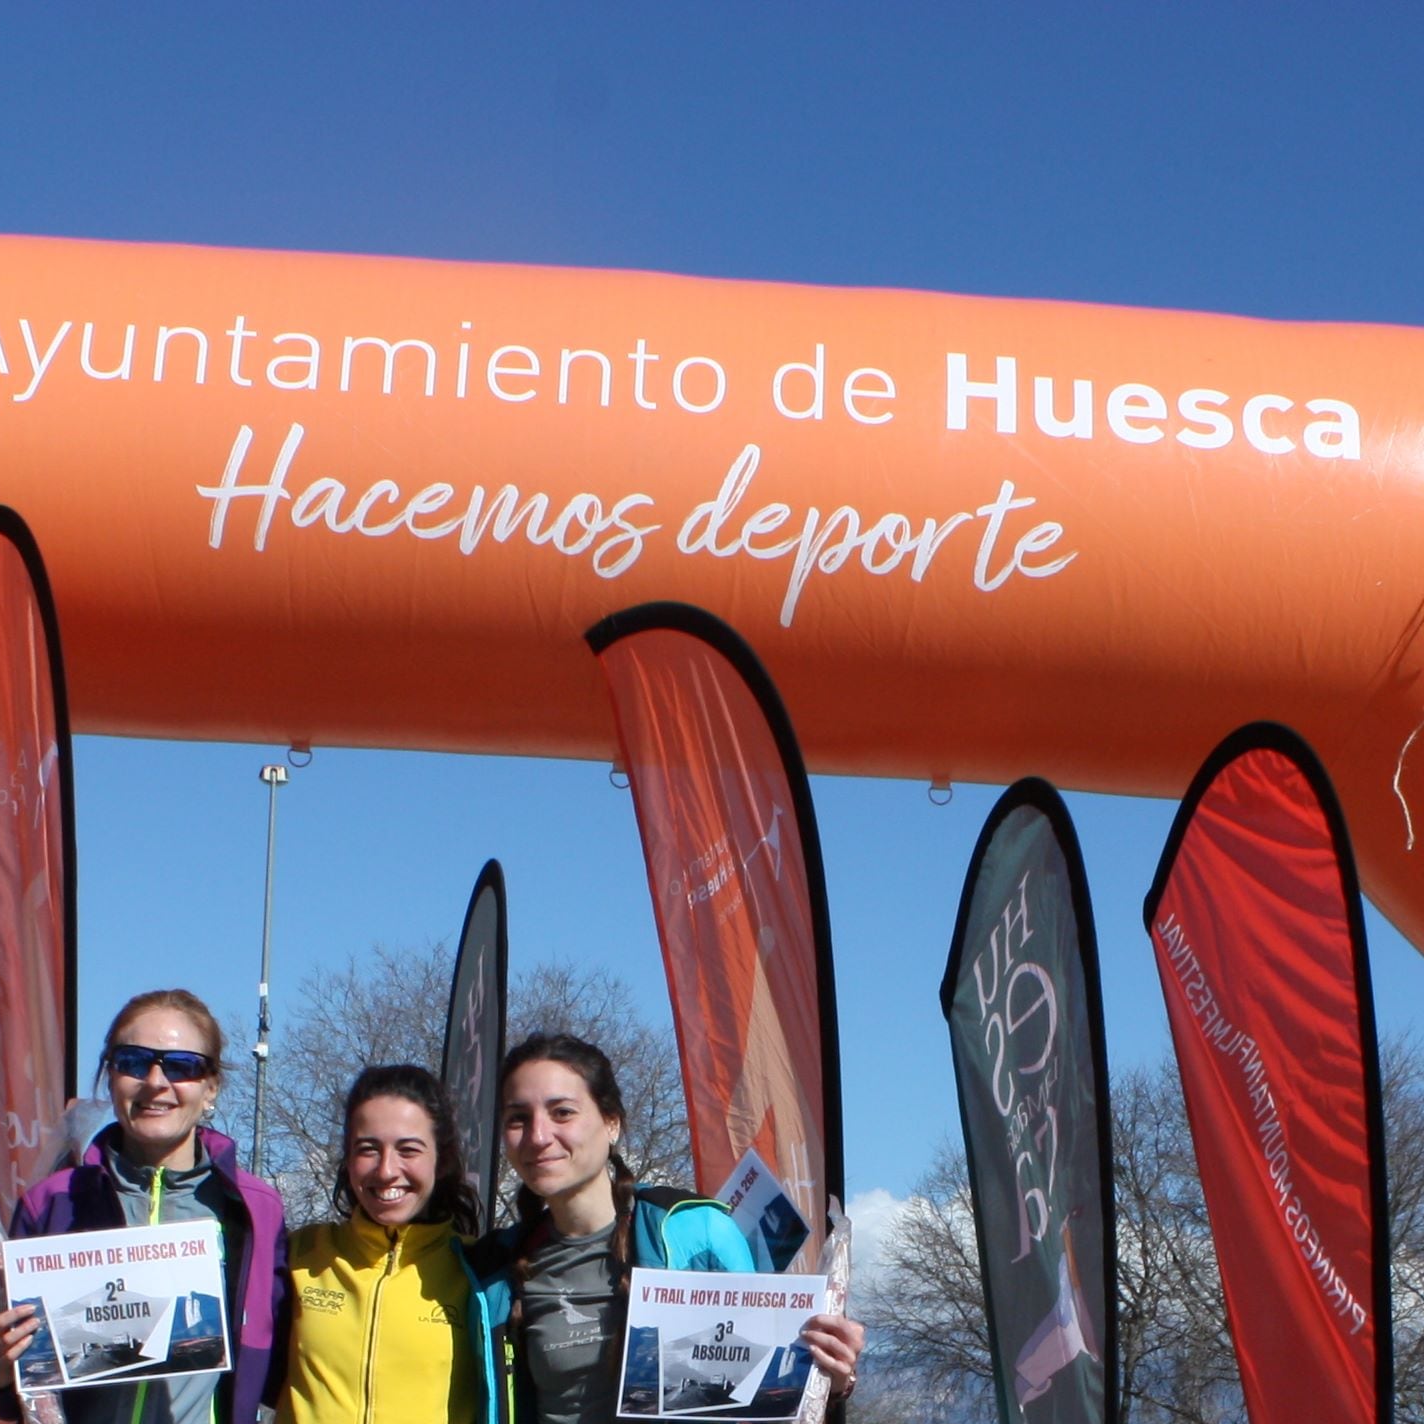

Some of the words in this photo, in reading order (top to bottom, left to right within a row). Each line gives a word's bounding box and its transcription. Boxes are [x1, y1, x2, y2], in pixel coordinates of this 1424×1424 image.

[772, 343, 899, 425] de
[944, 351, 1362, 461] Huesca
[197, 422, 654, 580] Hacemos
[676, 442, 1079, 628] deporte
[16, 1257, 25, 1274] V
[28, 1252, 65, 1273] TRAIL
[69, 1248, 103, 1269] HOYA
[107, 1247, 124, 1265] DE
[127, 1242, 177, 1263] HUESCA
[181, 1239, 207, 1258] 26K
[85, 1301, 151, 1324] ABSOLUTA
[641, 1286, 652, 1303] V
[654, 1287, 686, 1305] TRAIL
[690, 1289, 721, 1307] HOYA
[725, 1290, 739, 1307] DE
[741, 1291, 786, 1309] HUESCA
[790, 1292, 815, 1310] 26K
[691, 1344, 751, 1363] ABSOLUTA
